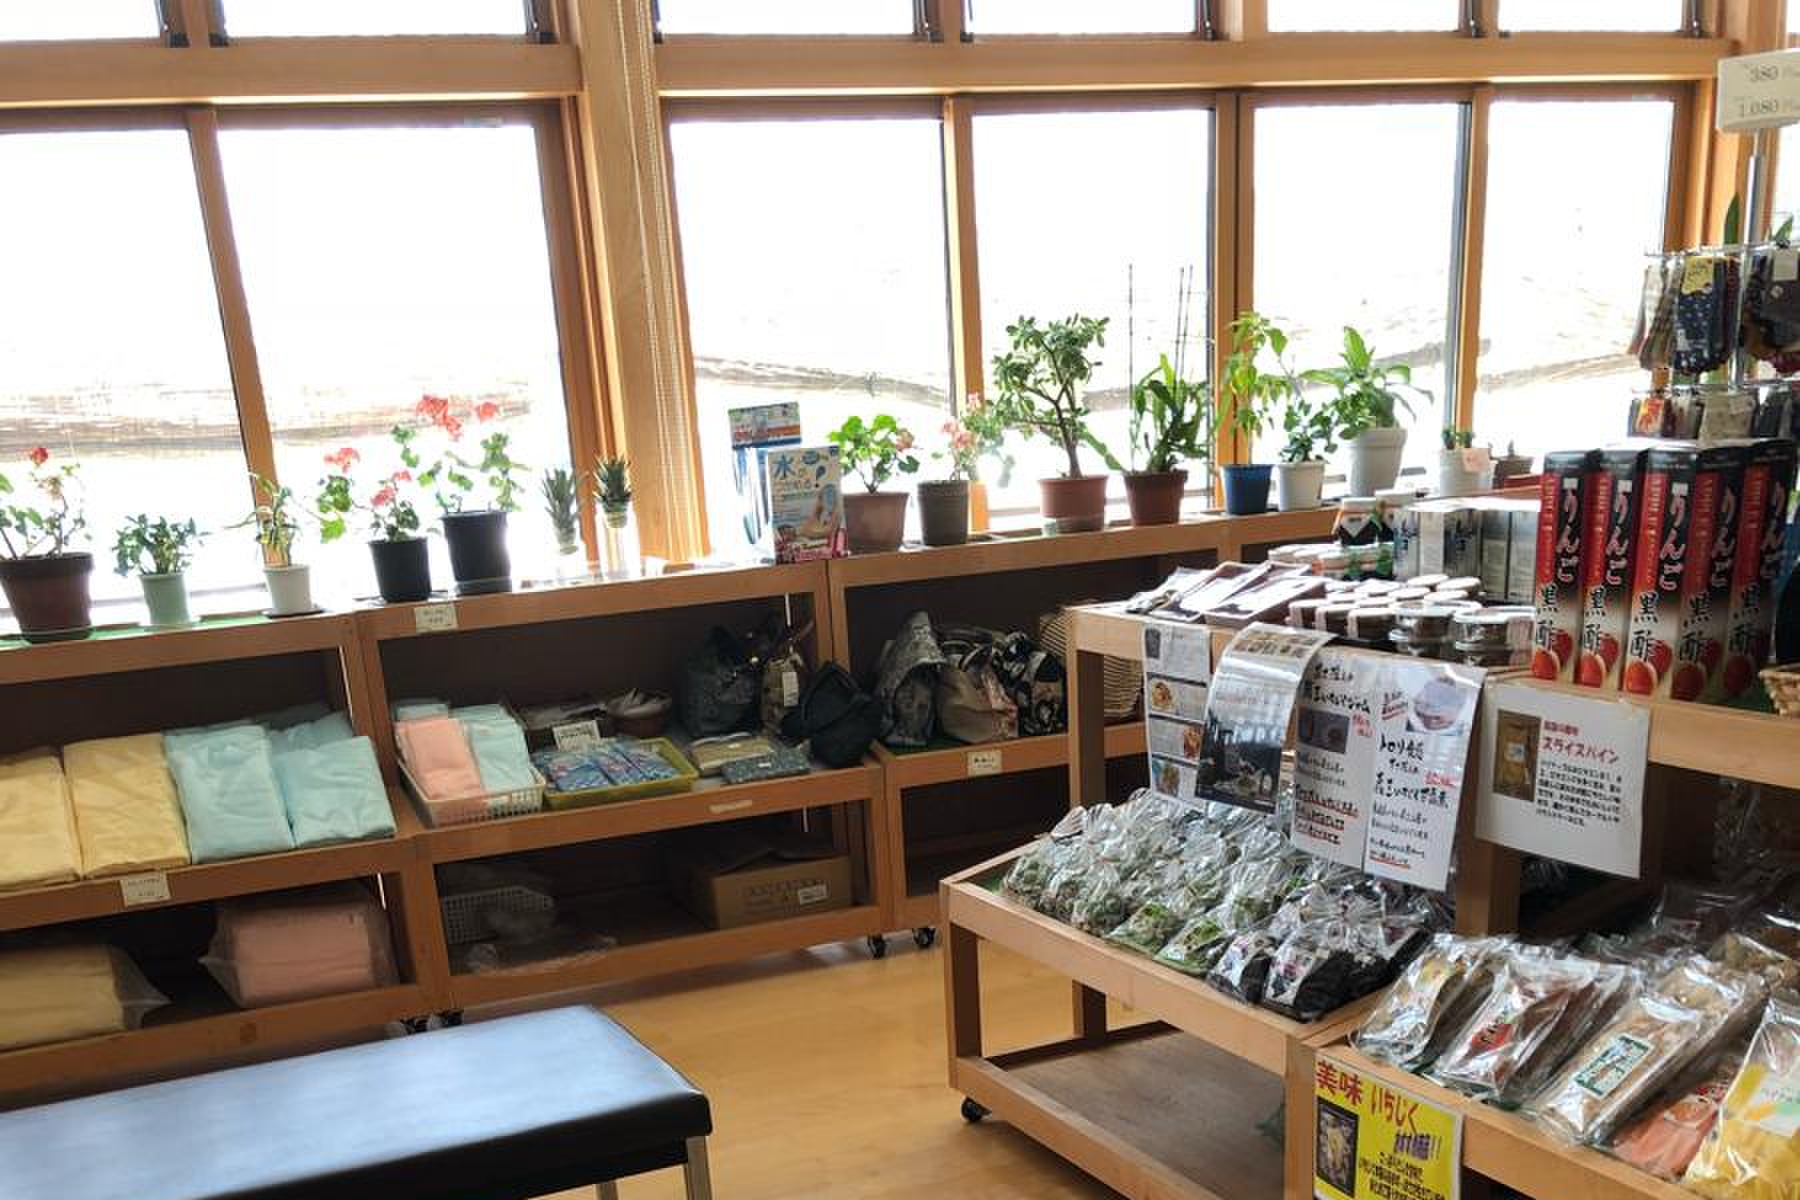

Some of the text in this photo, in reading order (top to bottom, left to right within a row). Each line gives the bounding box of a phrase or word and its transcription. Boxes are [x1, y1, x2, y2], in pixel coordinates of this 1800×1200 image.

[1557, 489, 1581, 584] りんご
[1605, 491, 1630, 586] りんご
[1659, 495, 1687, 592] りんご
[1711, 487, 1736, 588] りんご
[1536, 584, 1559, 652] 黒酢
[1583, 586, 1607, 655] 黒酢
[1630, 592, 1660, 663] 黒酢
[1680, 592, 1713, 663] 黒酢
[1316, 1060, 1420, 1134] 美味 いちじく
